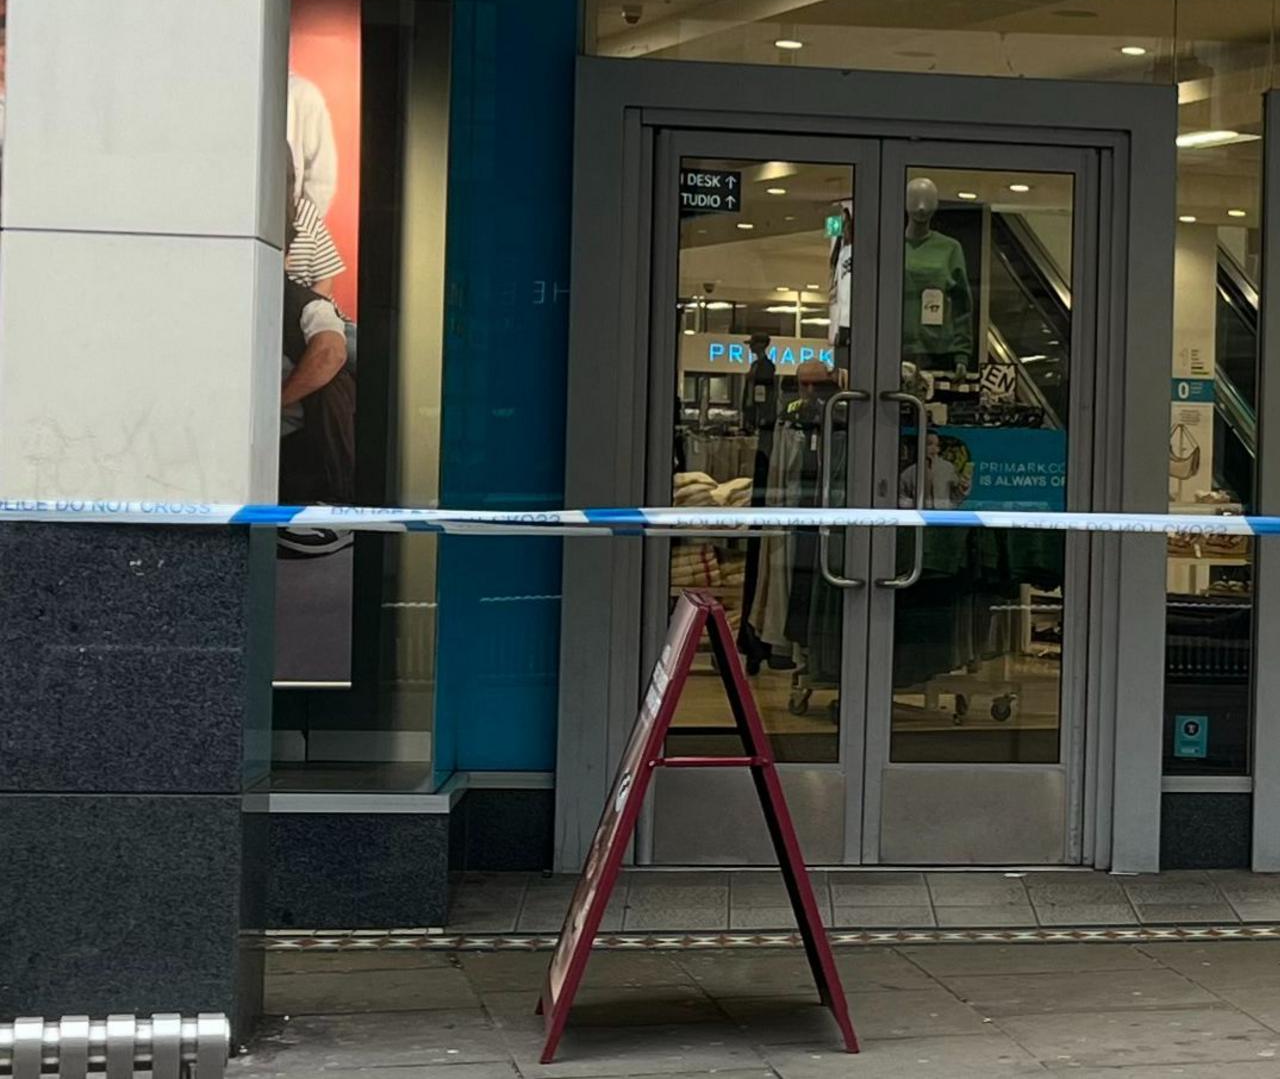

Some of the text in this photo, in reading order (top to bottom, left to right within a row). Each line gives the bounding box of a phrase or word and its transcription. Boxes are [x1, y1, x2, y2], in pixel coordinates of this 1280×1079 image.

[687, 173, 721, 187] DESK
[980, 475, 992, 486] IS
[995, 475, 1047, 487] ALWAYS
